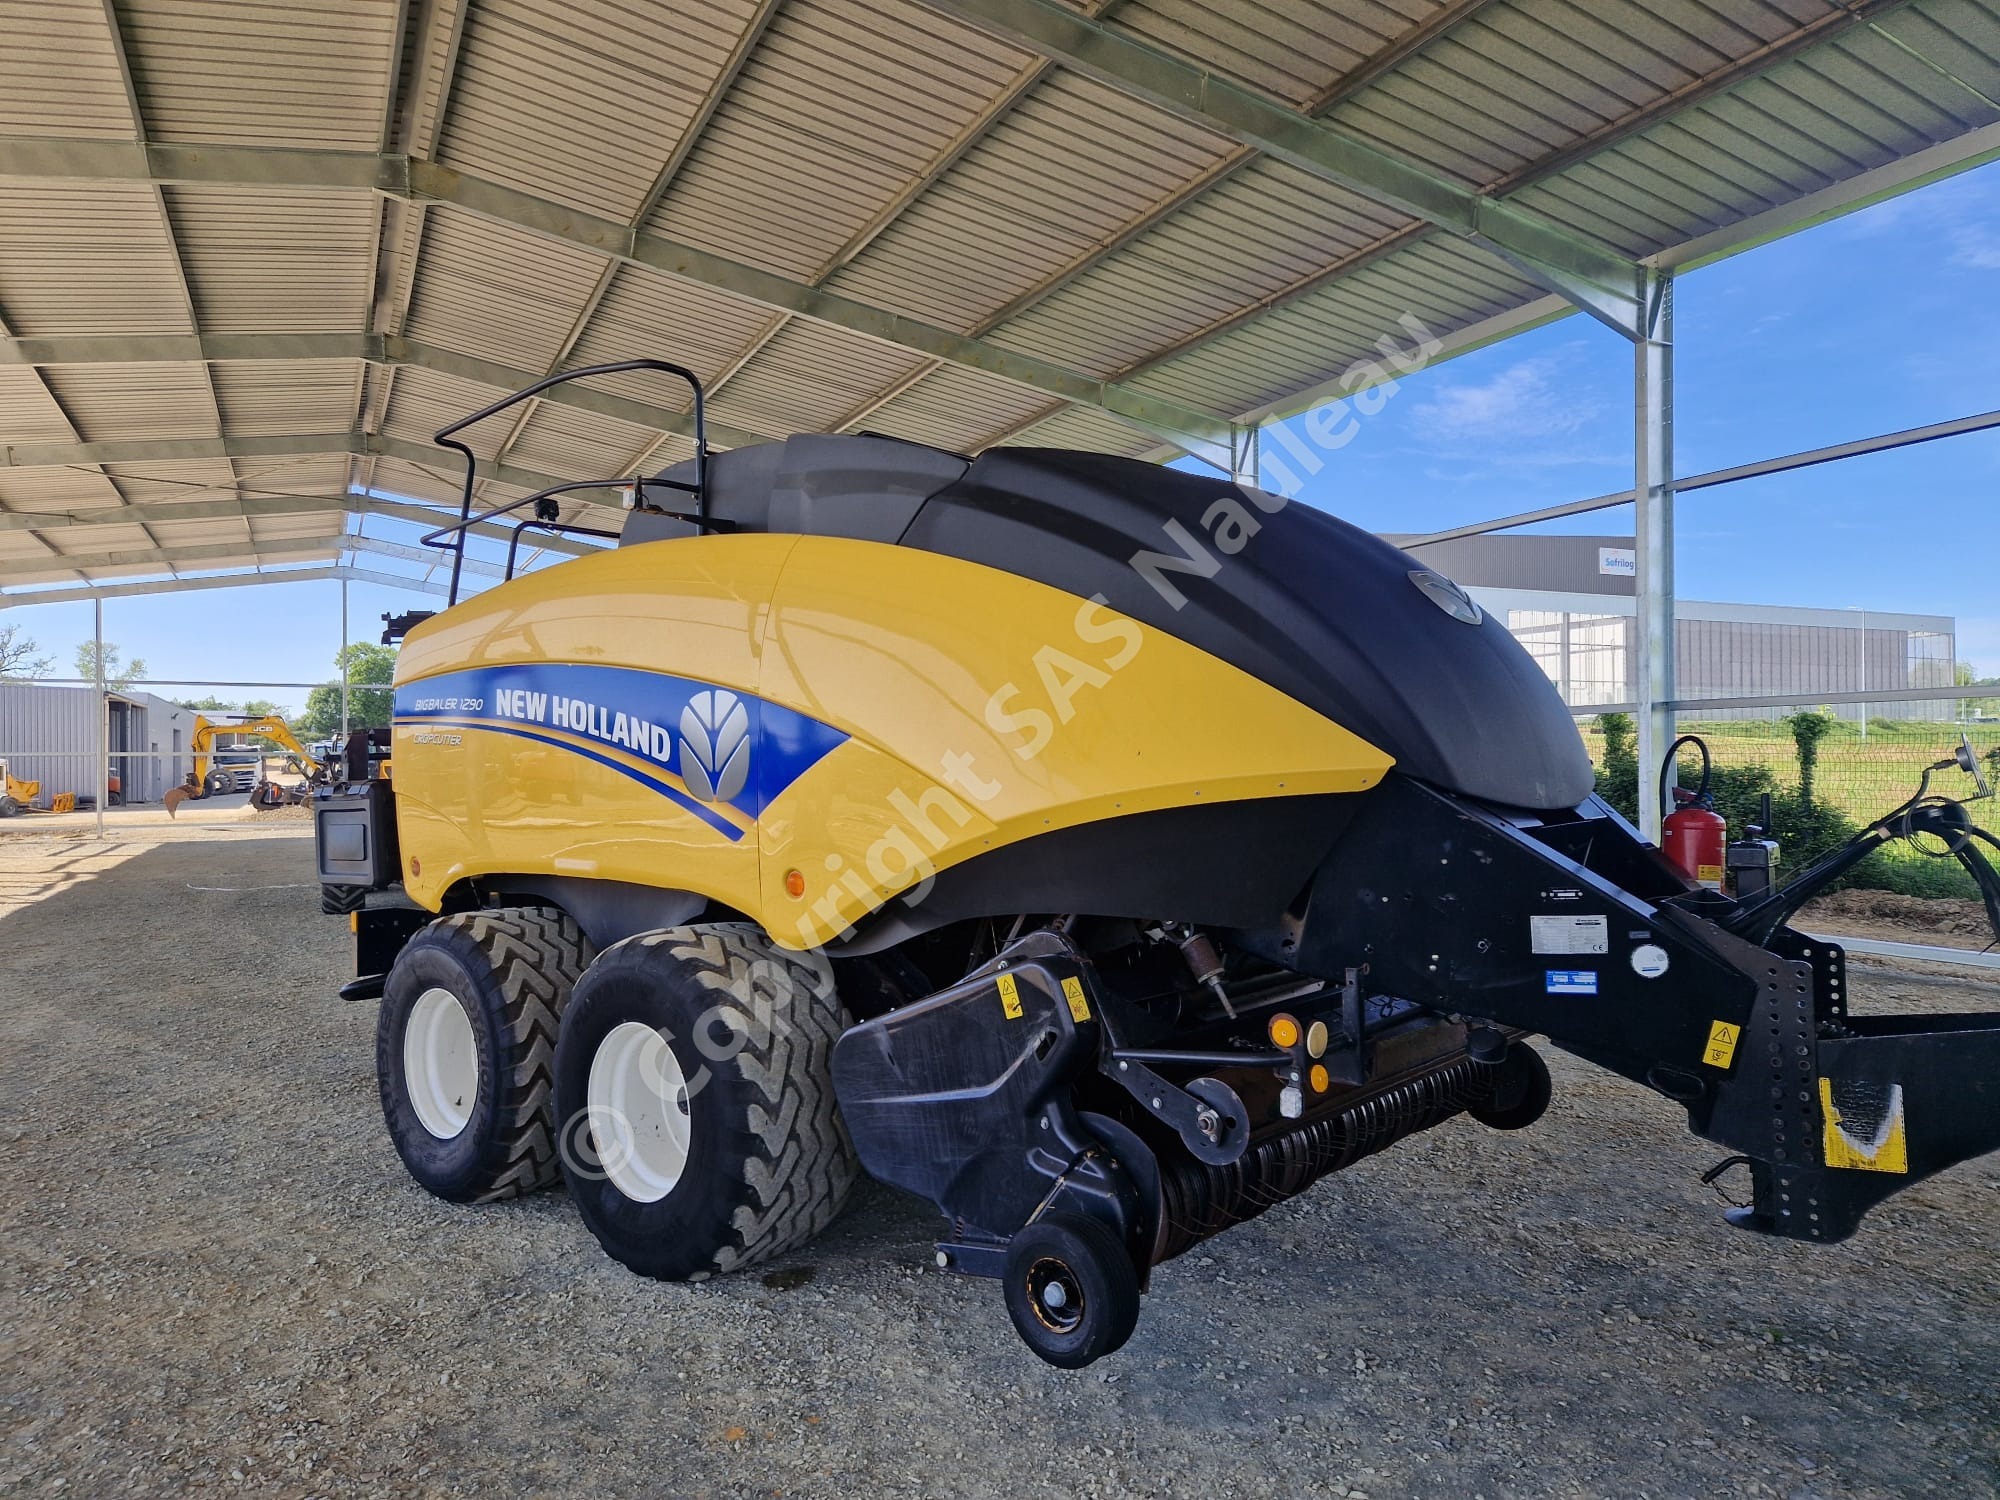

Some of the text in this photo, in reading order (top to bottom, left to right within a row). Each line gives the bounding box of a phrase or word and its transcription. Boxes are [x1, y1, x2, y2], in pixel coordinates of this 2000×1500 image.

[1605, 557, 1635, 570] Sofrilog
[415, 698, 483, 711] BIGBALER 1290
[496, 689, 671, 763] NEW HOLLAND
[413, 733, 462, 746] CROPCUTTER
